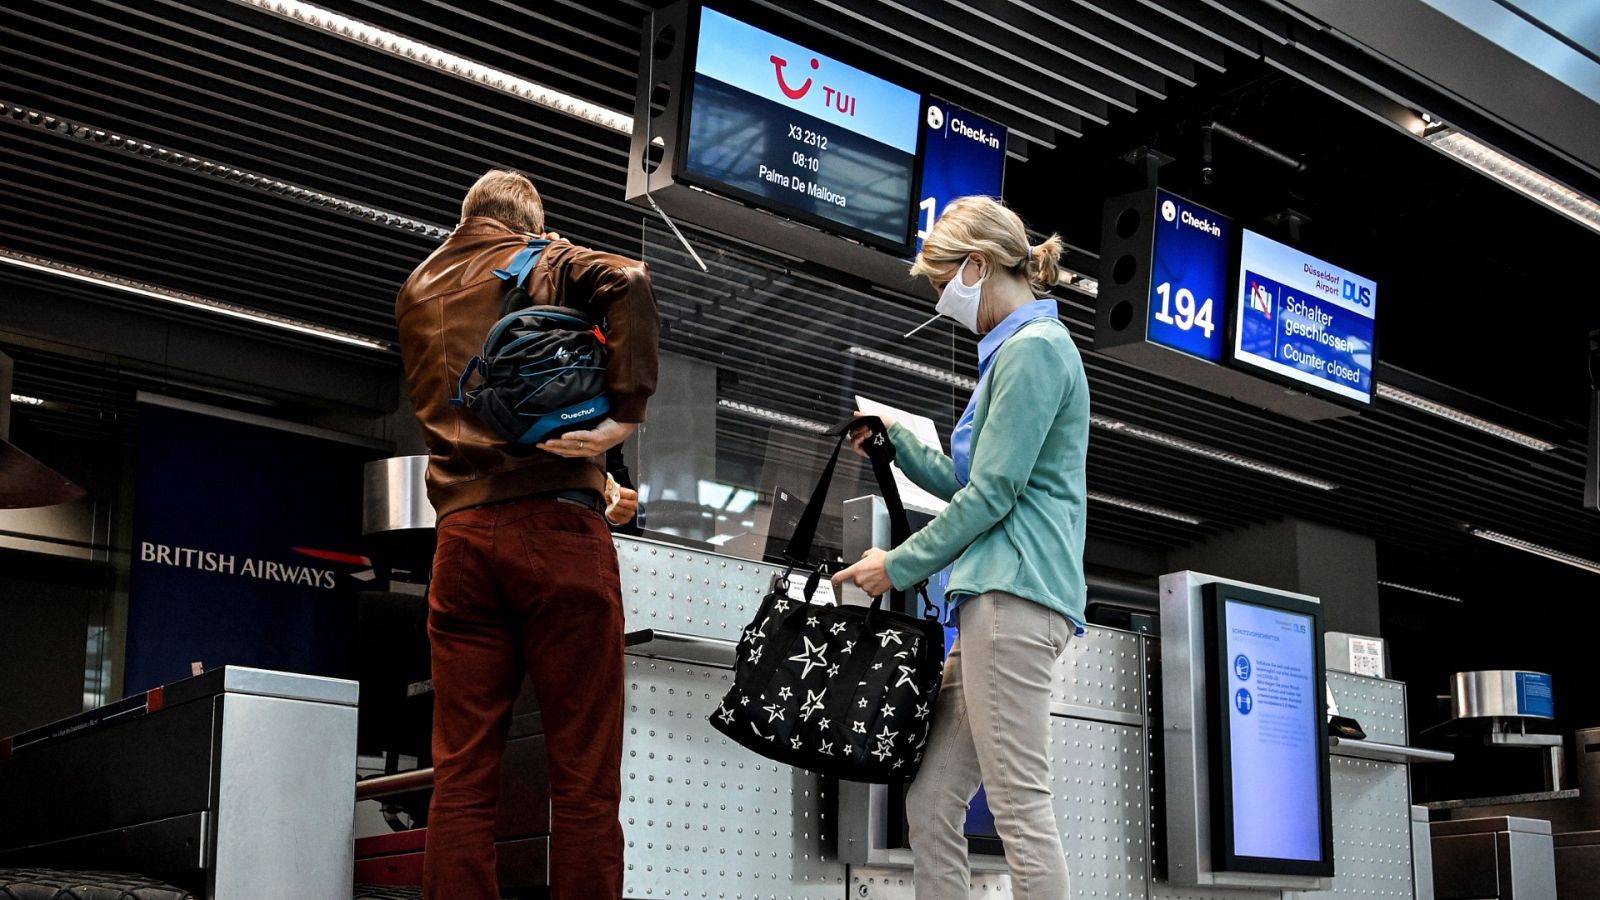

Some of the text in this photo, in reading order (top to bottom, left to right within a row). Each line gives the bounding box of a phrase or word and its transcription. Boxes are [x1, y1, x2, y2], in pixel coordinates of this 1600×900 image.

[823, 86, 856, 116] TUI
[788, 124, 827, 150] X3 2312
[951, 118, 1000, 149] Check-in
[792, 151, 819, 172] 08:10
[759, 164, 846, 207] Palma De Mallorca
[1181, 210, 1221, 237] Check-in
[1303, 263, 1340, 285] Düsseldorf
[1315, 280, 1339, 297] Airport
[1342, 279, 1371, 308] DUS
[1155, 282, 1215, 338] 194
[1286, 296, 1333, 327] Schalter
[1285, 318, 1354, 354] geschlossen
[1283, 343, 1360, 383] Counter closed
[141, 541, 336, 590] BRITISH AIRWAYS
